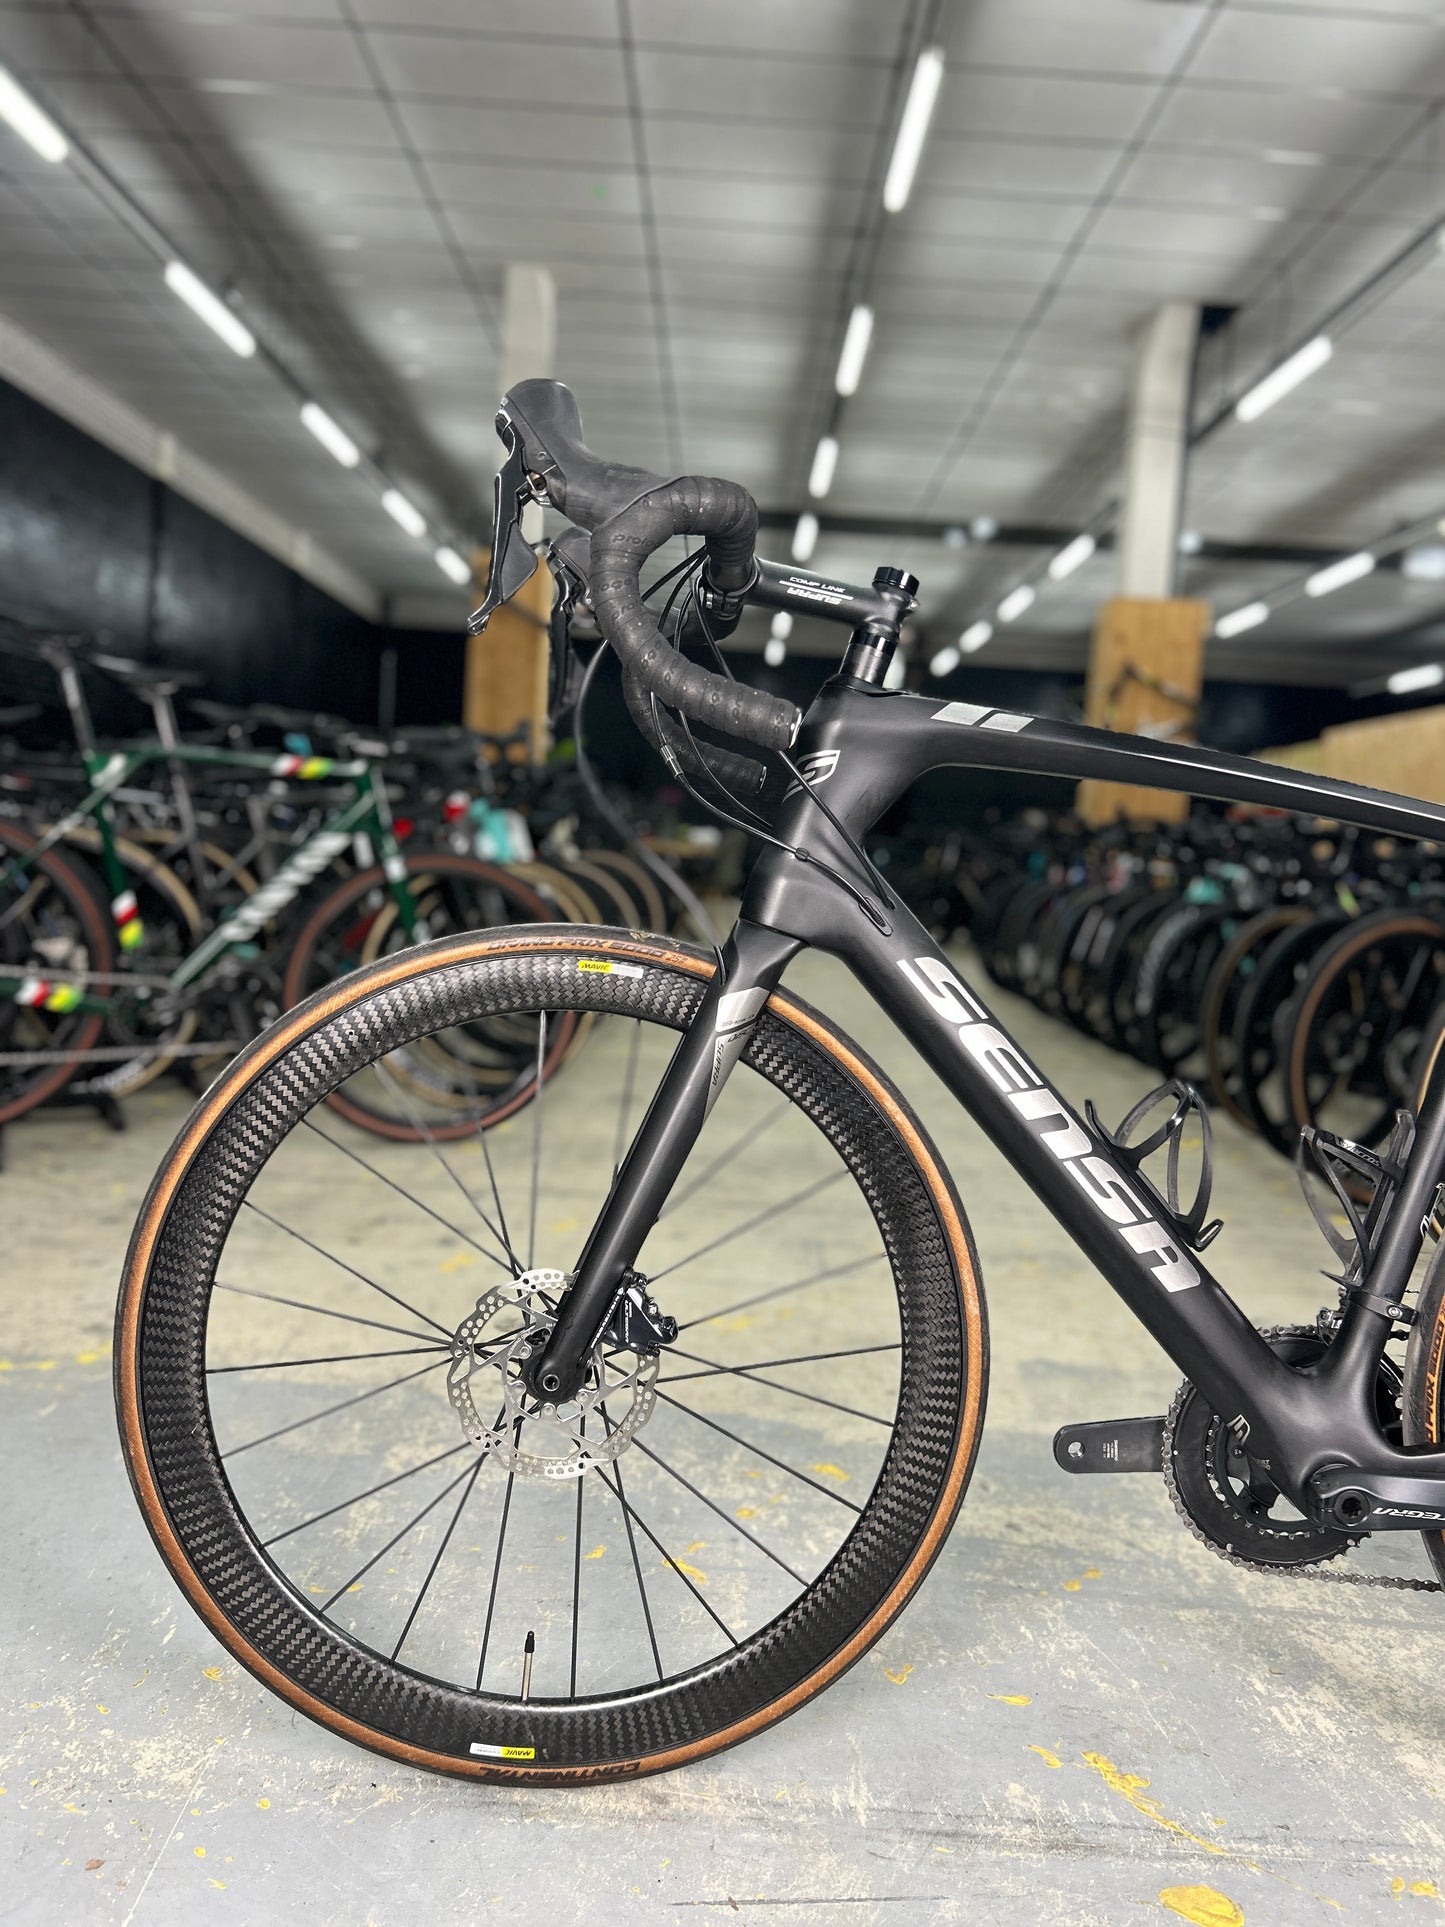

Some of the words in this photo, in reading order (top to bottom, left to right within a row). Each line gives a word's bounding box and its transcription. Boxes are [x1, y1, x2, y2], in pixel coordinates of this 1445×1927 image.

[789, 576, 821, 587] COMP
[821, 583, 846, 593] LINE
[786, 586, 843, 605] SUPRA
[557, 936, 607, 949] PRIX
[608, 939, 668, 958] 5000
[581, 963, 610, 971] MAVIC
[505, 1749, 532, 1757] MAVIC
[479, 1761, 641, 1781] CONTINENTAL
